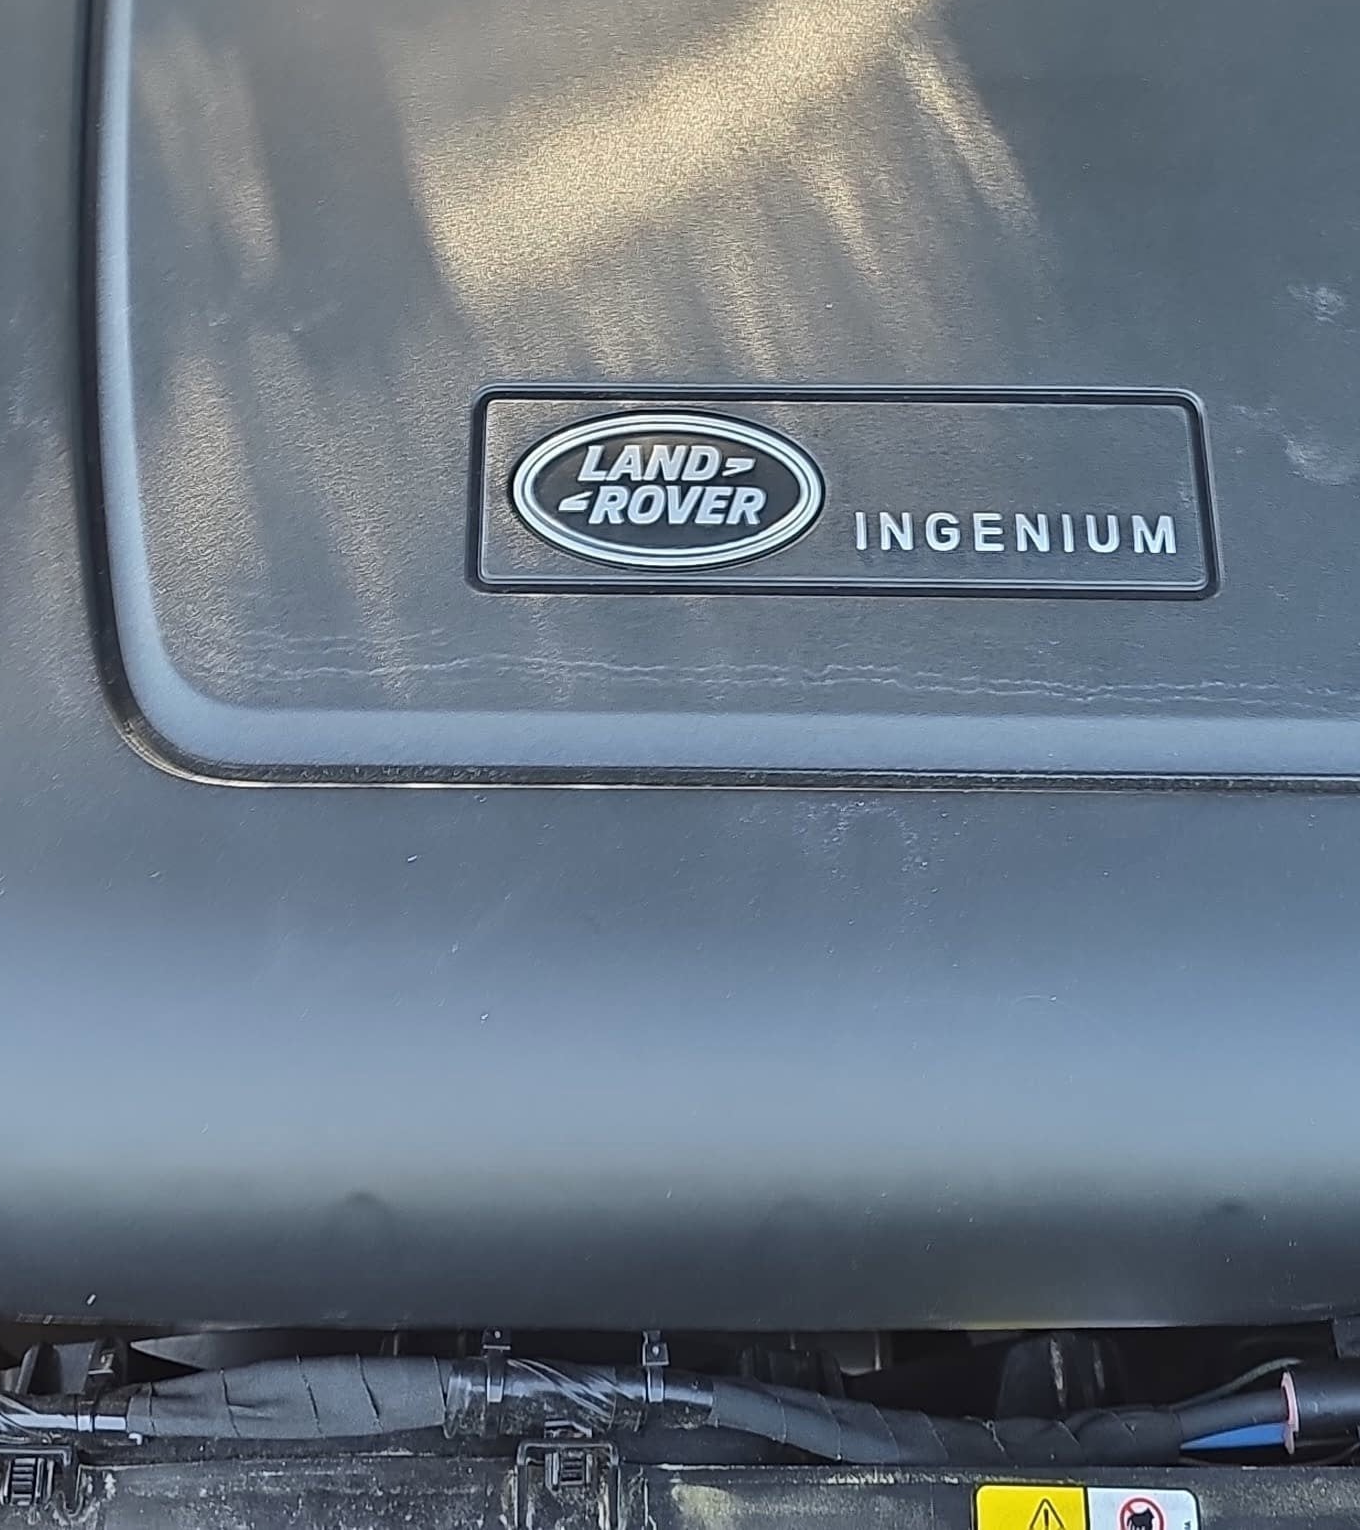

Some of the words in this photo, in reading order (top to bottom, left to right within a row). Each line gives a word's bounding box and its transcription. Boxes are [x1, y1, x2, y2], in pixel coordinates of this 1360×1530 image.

[578, 444, 722, 482] LAND
[588, 486, 768, 526] ROVER
[855, 511, 1177, 555] INGENIUM
